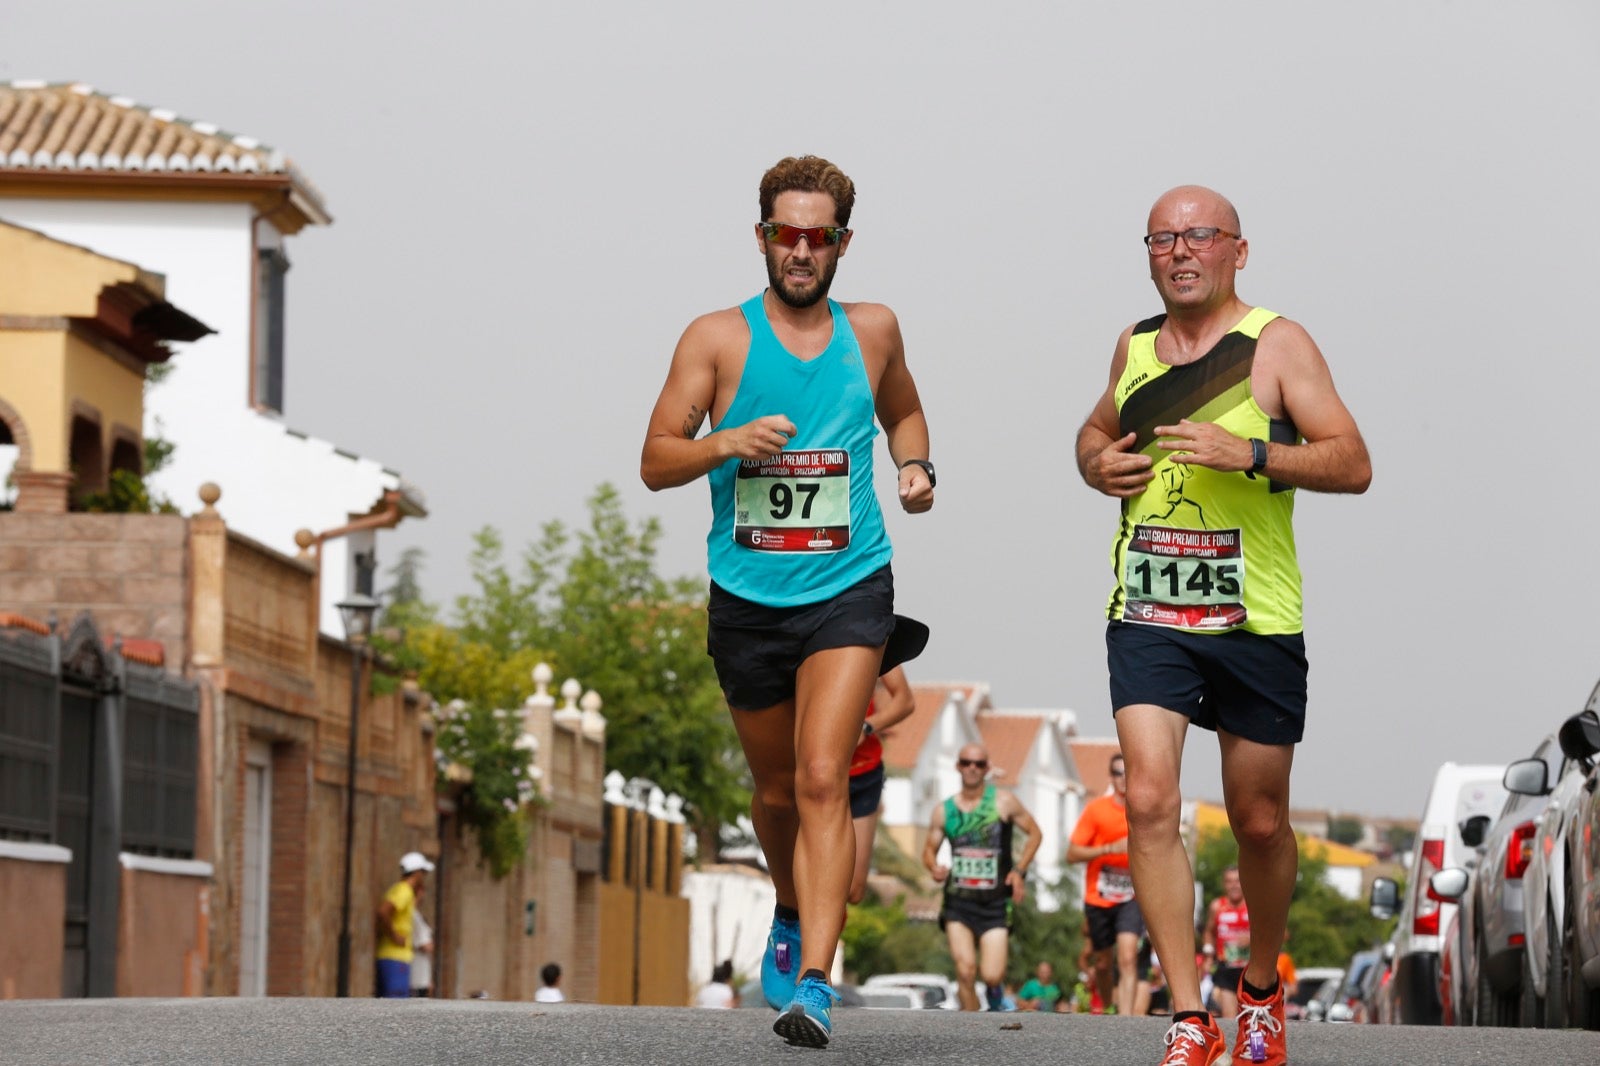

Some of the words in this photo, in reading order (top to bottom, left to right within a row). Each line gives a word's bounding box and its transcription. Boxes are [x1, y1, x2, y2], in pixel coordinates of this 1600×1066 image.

[782, 453, 809, 466] PREMIO
[811, 453, 820, 465] DE
[821, 452, 844, 465] FONDO
[760, 467, 790, 475] DIPUTACIÓN
[794, 467, 826, 475] CRUZCAMPO
[769, 482, 820, 520] 97
[1152, 530, 1172, 544] GRAN
[1172, 532, 1200, 546] PREMIO
[1201, 534, 1211, 547] DE
[1212, 533, 1234, 546] FONDO
[1134, 559, 1240, 596] 1145
